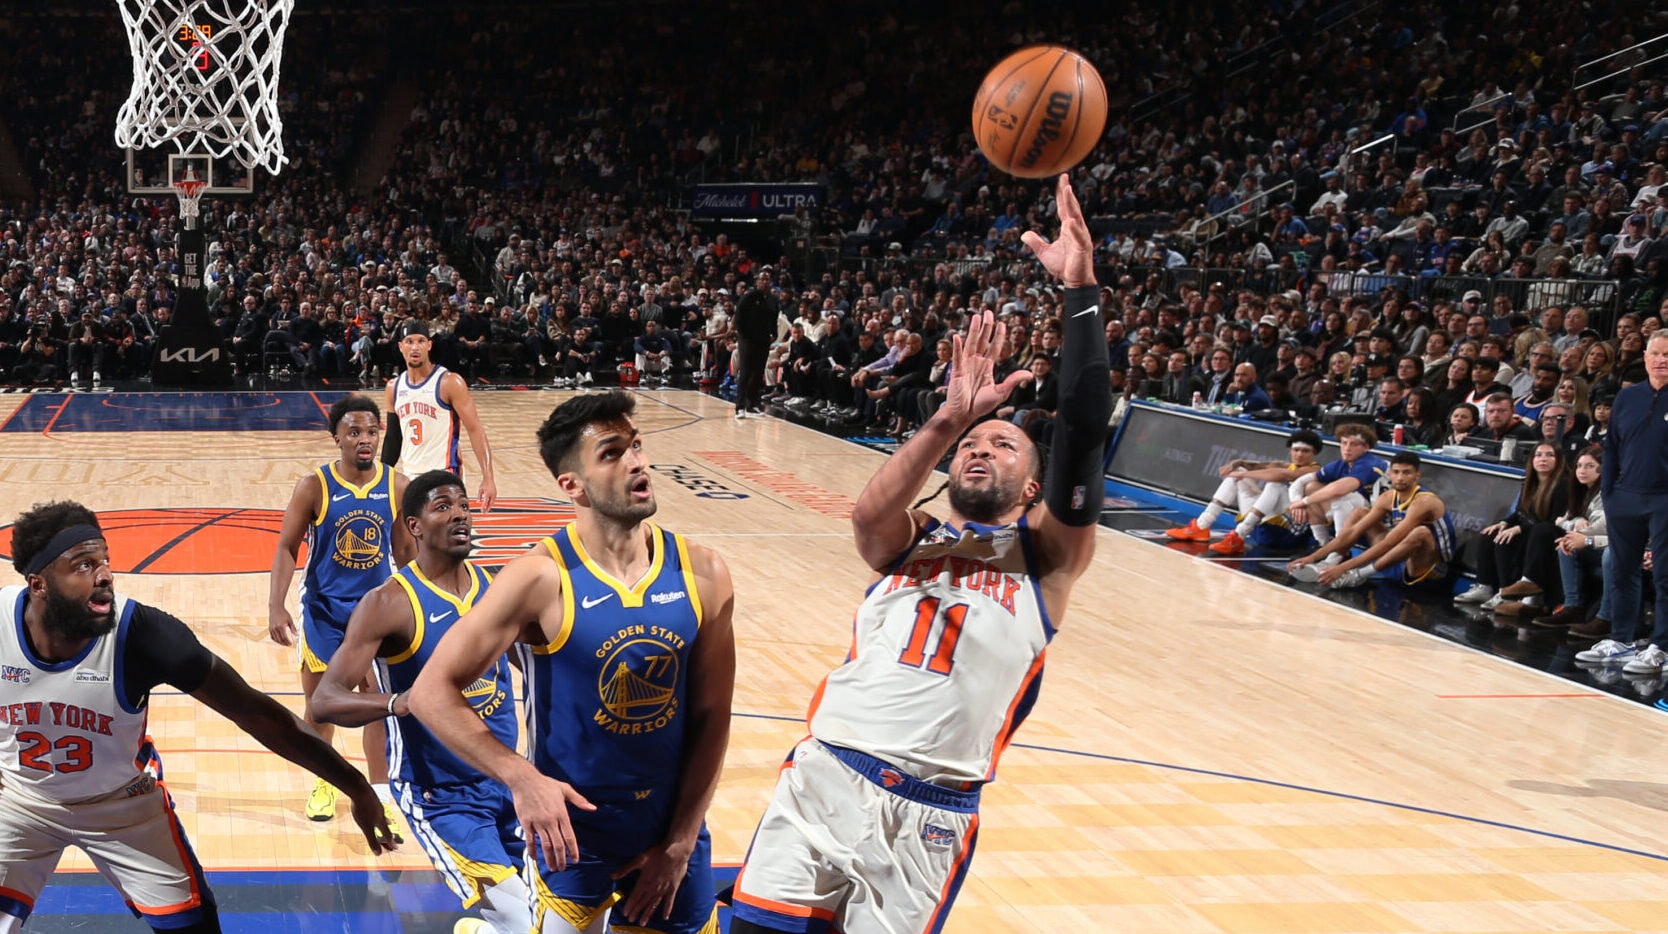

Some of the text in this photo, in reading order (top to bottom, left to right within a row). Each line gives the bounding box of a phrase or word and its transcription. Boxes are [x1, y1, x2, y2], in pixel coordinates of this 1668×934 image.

[762, 194, 817, 208] ULTRA
[184, 253, 197, 264] GET
[185, 265, 198, 275] THE
[188, 277, 201, 290] App
[160, 347, 220, 362] KIA
[413, 402, 438, 420] YORK
[409, 418, 423, 446] 3
[334, 509, 385, 528] GOLDEN STATE
[364, 527, 376, 541] 18
[332, 551, 385, 571] WARRIORS
[883, 554, 1021, 617] NEW YORK
[651, 590, 685, 604] Rakuten
[595, 624, 687, 660] GOLDEN STATE
[897, 595, 970, 678] 11
[1, 664, 31, 684] NYC
[643, 655, 673, 680] 77
[0, 702, 114, 737] NEW YORK
[592, 697, 679, 735] WARRIORS
[16, 731, 94, 774] 23
